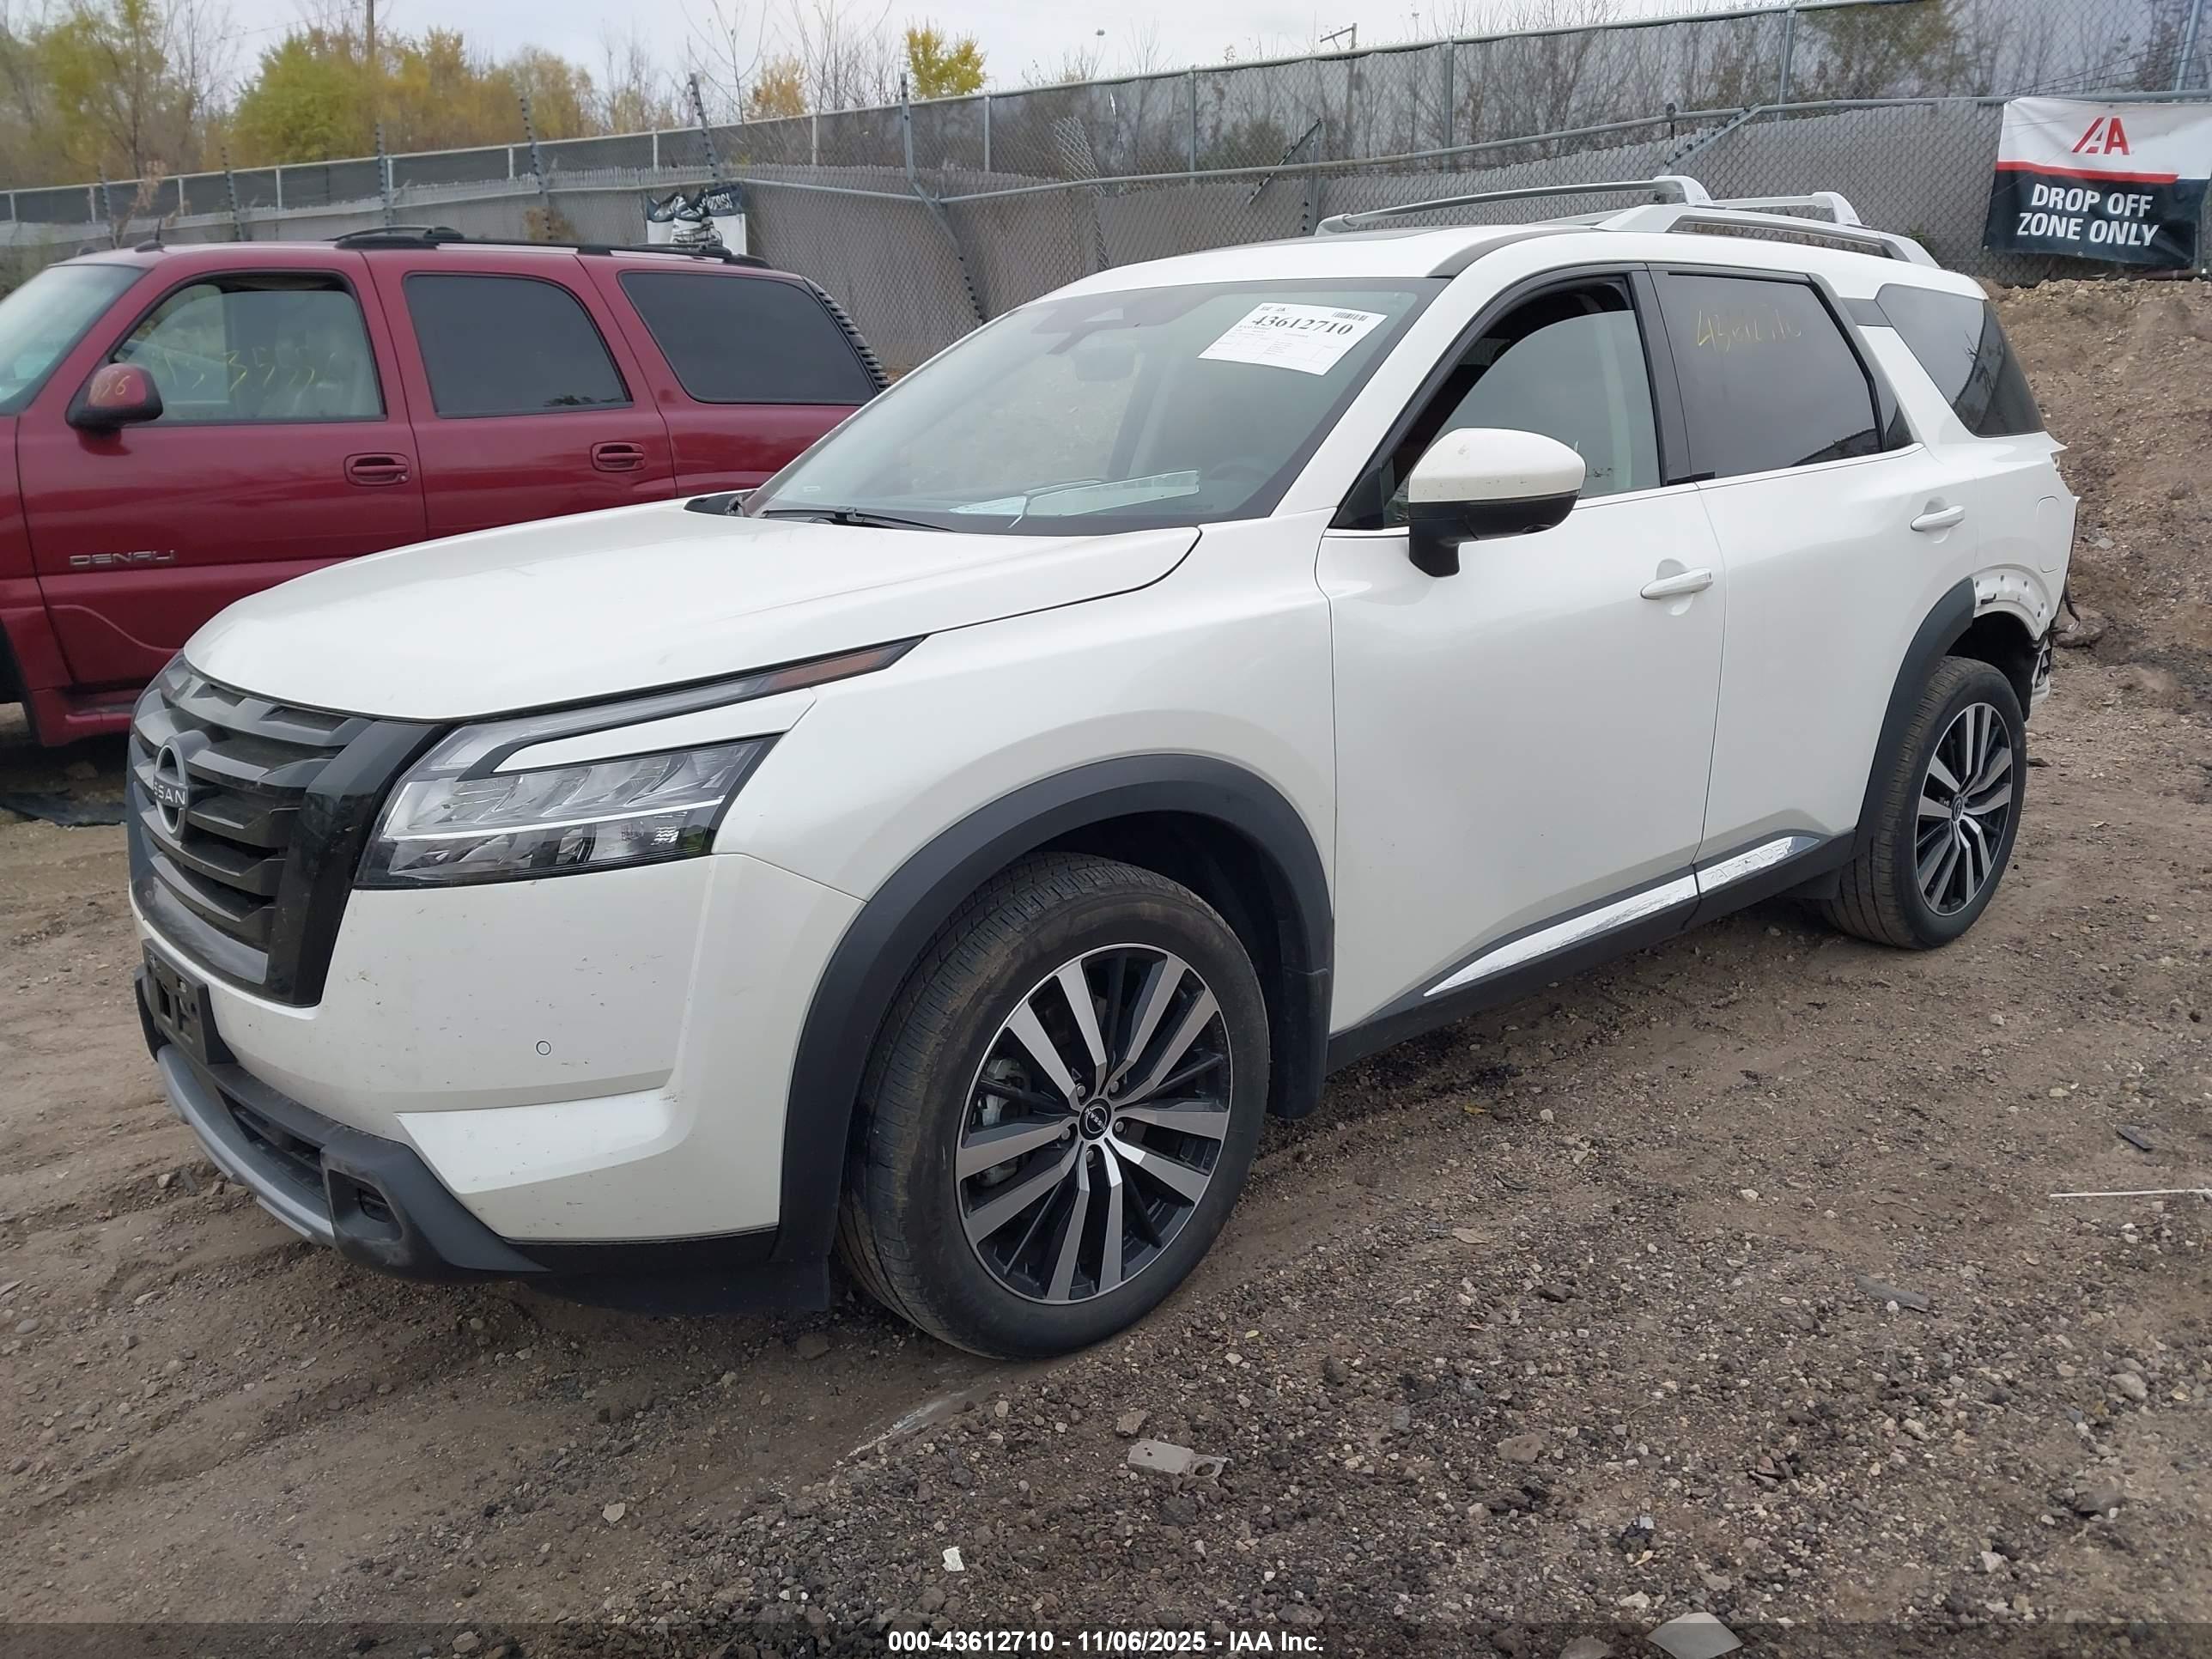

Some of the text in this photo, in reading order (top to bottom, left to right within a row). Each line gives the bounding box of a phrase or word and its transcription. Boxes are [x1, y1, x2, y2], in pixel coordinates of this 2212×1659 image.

[2031, 183, 2154, 217] DROP OFF
[2016, 212, 2160, 246] ZONE ONLY
[1252, 315, 1354, 336] 43612710
[70, 550, 174, 565] DENALI
